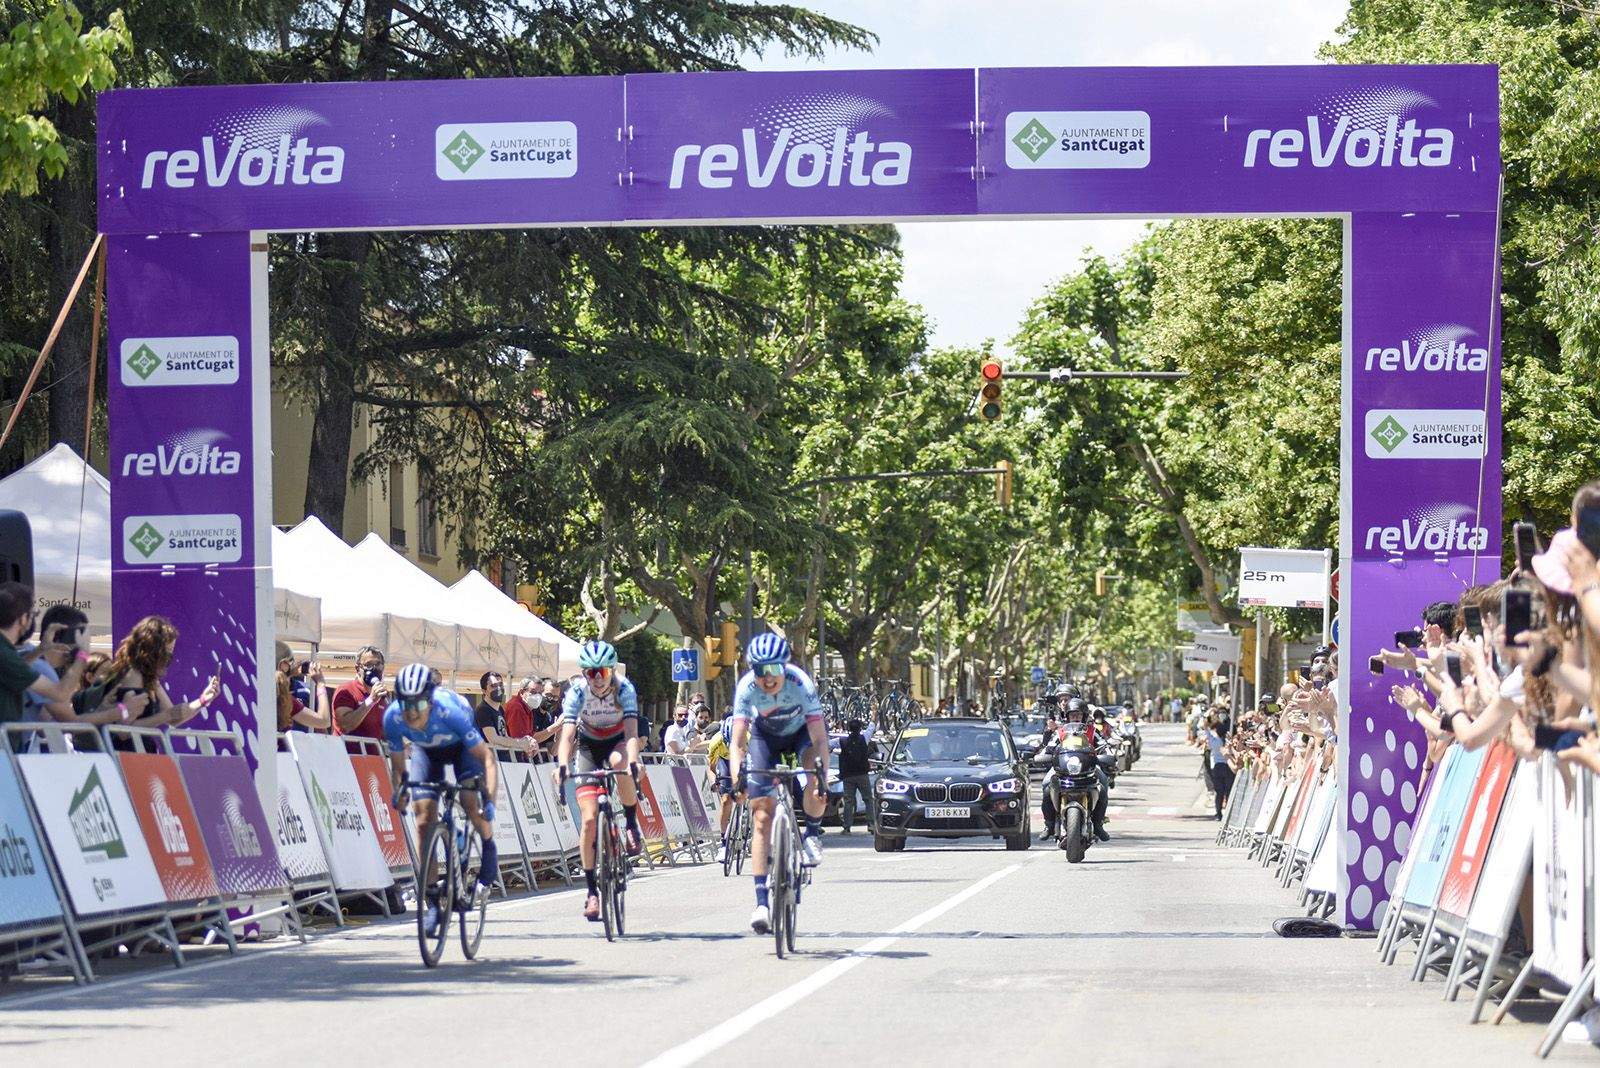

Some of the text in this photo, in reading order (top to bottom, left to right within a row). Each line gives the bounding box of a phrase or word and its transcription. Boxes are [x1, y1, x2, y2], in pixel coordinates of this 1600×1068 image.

[1061, 128, 1145, 139] AJUNTAMENT DE
[490, 137, 572, 149] AJUNTAMENT DE
[1061, 138, 1145, 152] SantCugat
[1243, 114, 1454, 168] reVolta
[141, 132, 346, 189] reVolta
[490, 148, 572, 163] SantCugat
[669, 126, 912, 189] reVolta
[166, 350, 234, 359] AJUNTAMENT DE
[1365, 340, 1488, 372] reVolta
[166, 359, 234, 373] SantCugat
[1412, 424, 1483, 433] AJUNTAMENT DE
[1412, 433, 1483, 447] SantCugat
[122, 444, 241, 476] reVolta
[169, 528, 237, 537] AJUNTAMENT DE
[1365, 518, 1488, 551] reVolta
[169, 537, 237, 551] SantCugat
[1243, 571, 1285, 582] 25 m
[931, 808, 951, 817] 3216
